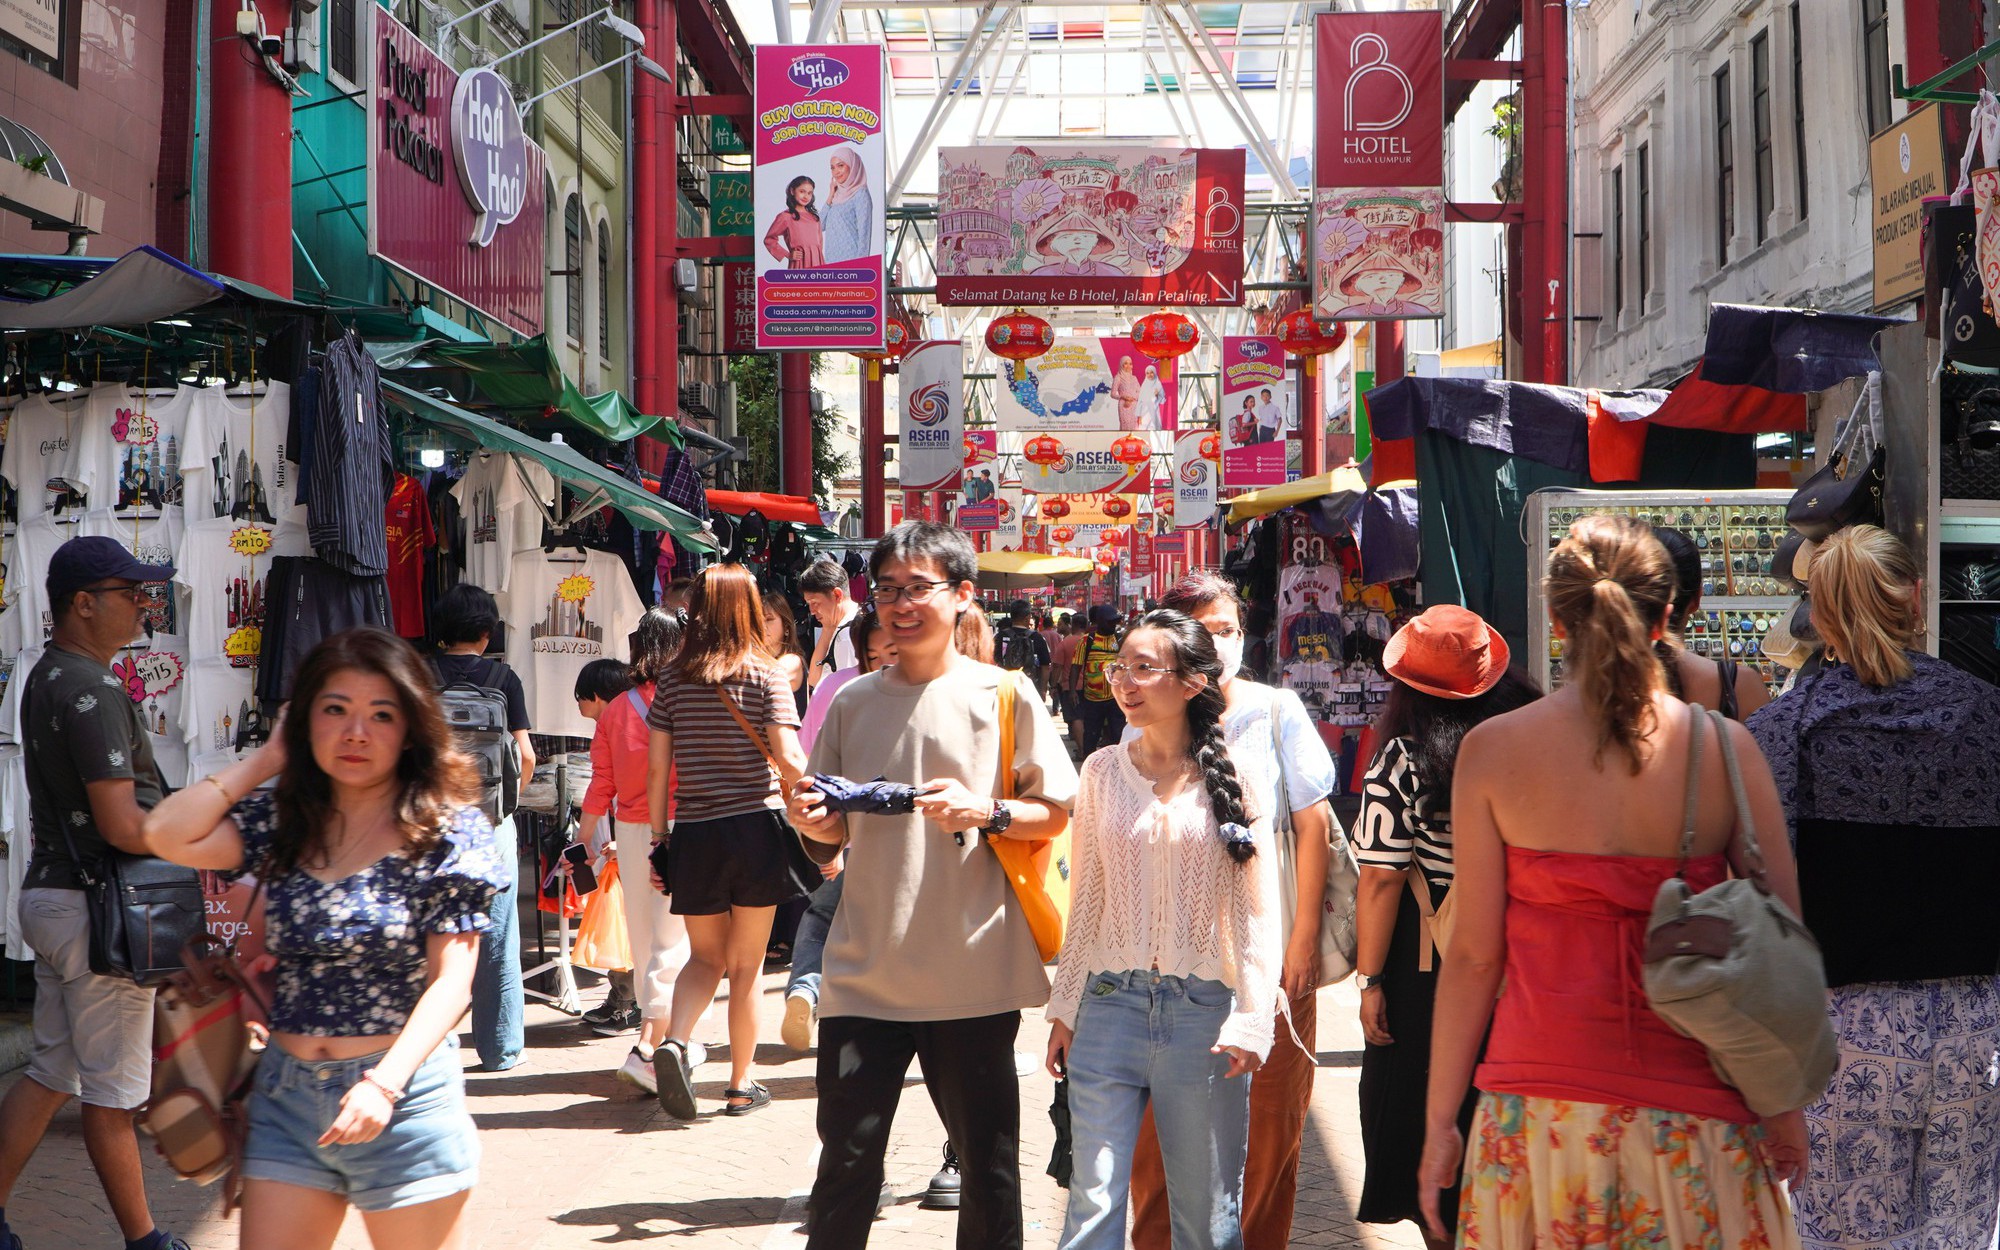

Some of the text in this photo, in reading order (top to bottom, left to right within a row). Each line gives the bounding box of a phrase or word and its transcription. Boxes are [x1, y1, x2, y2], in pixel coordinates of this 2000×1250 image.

[794, 60, 826, 76] Hari
[386, 38, 427, 115] Pusat
[811, 72, 843, 88] Hari
[468, 79, 504, 149] Hari
[761, 105, 790, 128] BUY
[845, 105, 878, 127] NOW
[386, 99, 443, 187] Pakaian
[1344, 137, 1412, 154] HOTEL
[488, 149, 520, 215] Hari
[715, 180, 750, 198] Ho
[1880, 172, 1936, 216] DILARANG MENJUAL
[1876, 222, 1899, 248] PRODUK
[1900, 210, 1918, 236] CETAK
[1204, 240, 1238, 248] HOTEL
[784, 272, 858, 280] www.ehari.com
[950, 288, 1211, 304] Selamat Datang ke B Hotel, Jalan Petaling.
[1242, 343, 1258, 351] Hari
[1250, 349, 1266, 357] Hari
[909, 430, 950, 441] ASEAN
[277, 444, 285, 488] Malaysia
[1180, 488, 1208, 496] ASEAN
[532, 640, 602, 655] MALAYSIA
[204, 900, 231, 914] ax.
[206, 922, 252, 940] urge.
